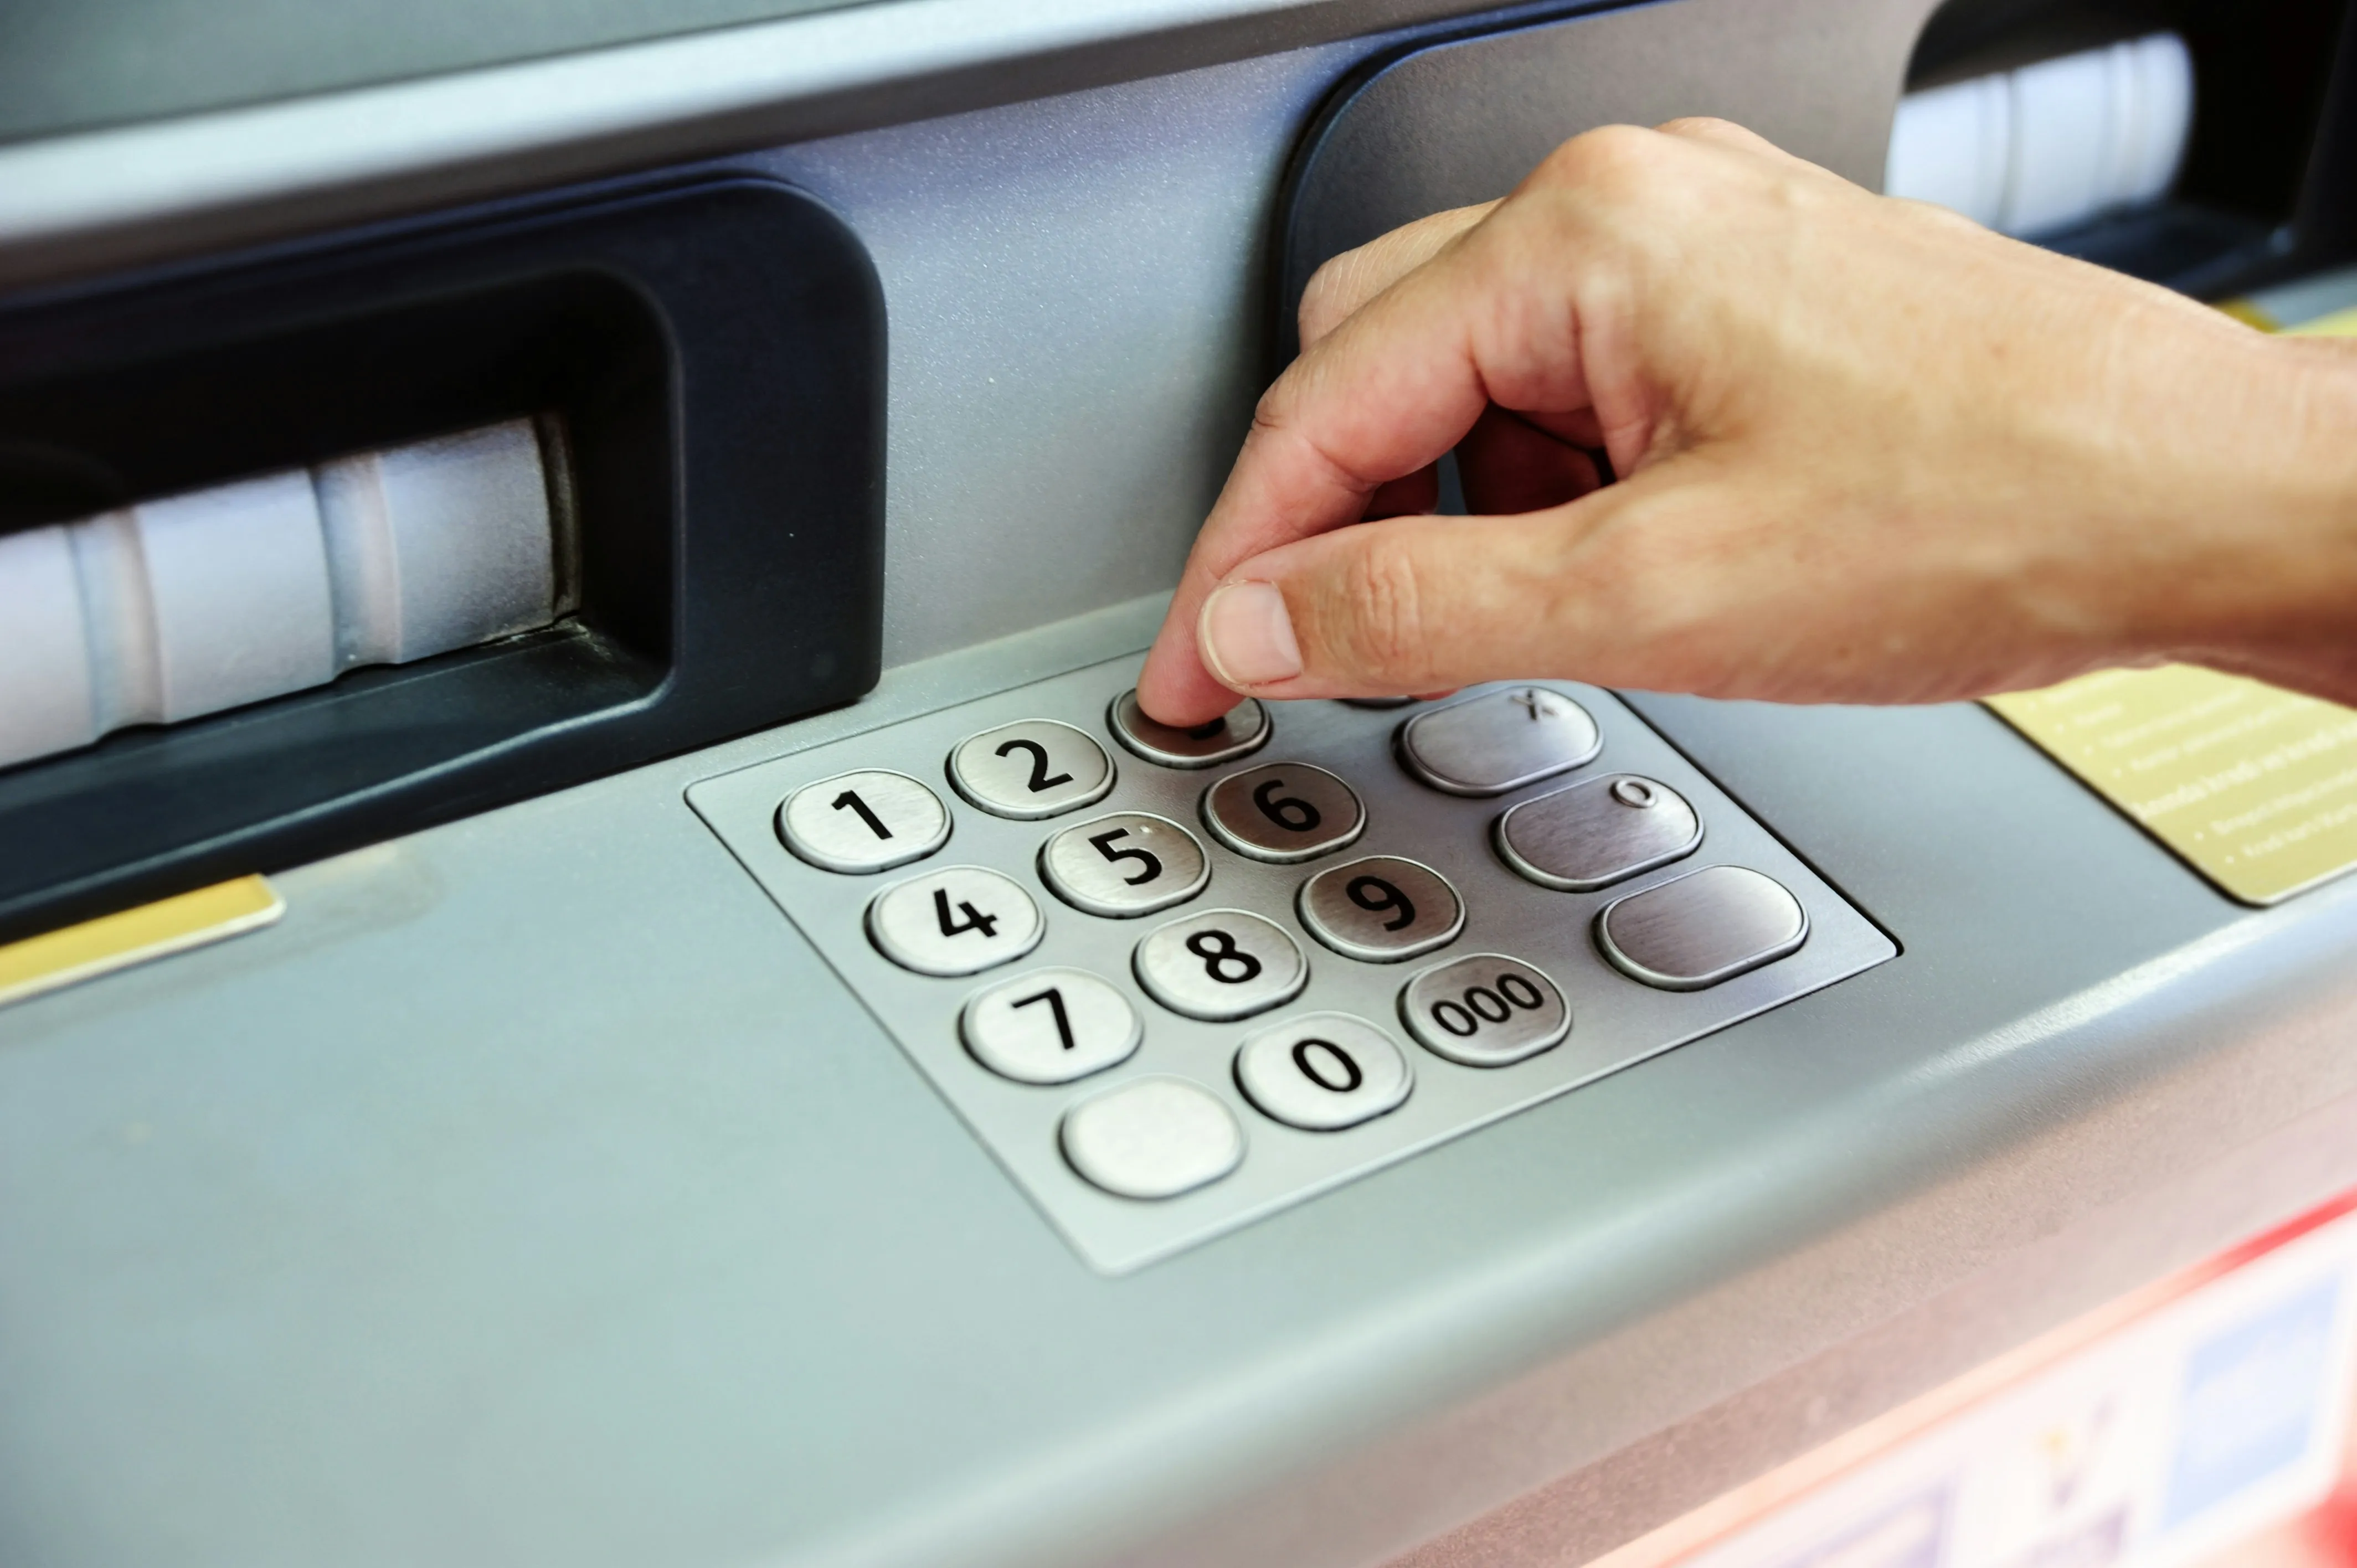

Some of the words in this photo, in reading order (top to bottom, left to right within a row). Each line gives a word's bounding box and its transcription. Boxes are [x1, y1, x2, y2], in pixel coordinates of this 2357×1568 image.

[995, 739, 1074, 793] 2
[831, 790, 893, 840] 1
[1253, 779, 1321, 832] 6
[1088, 828, 1162, 886] 5
[934, 888, 997, 938] 4
[1345, 875, 1416, 932] 9
[1186, 930, 1262, 984] 8
[1012, 988, 1075, 1050] 7
[1291, 1038, 1362, 1093] 0
